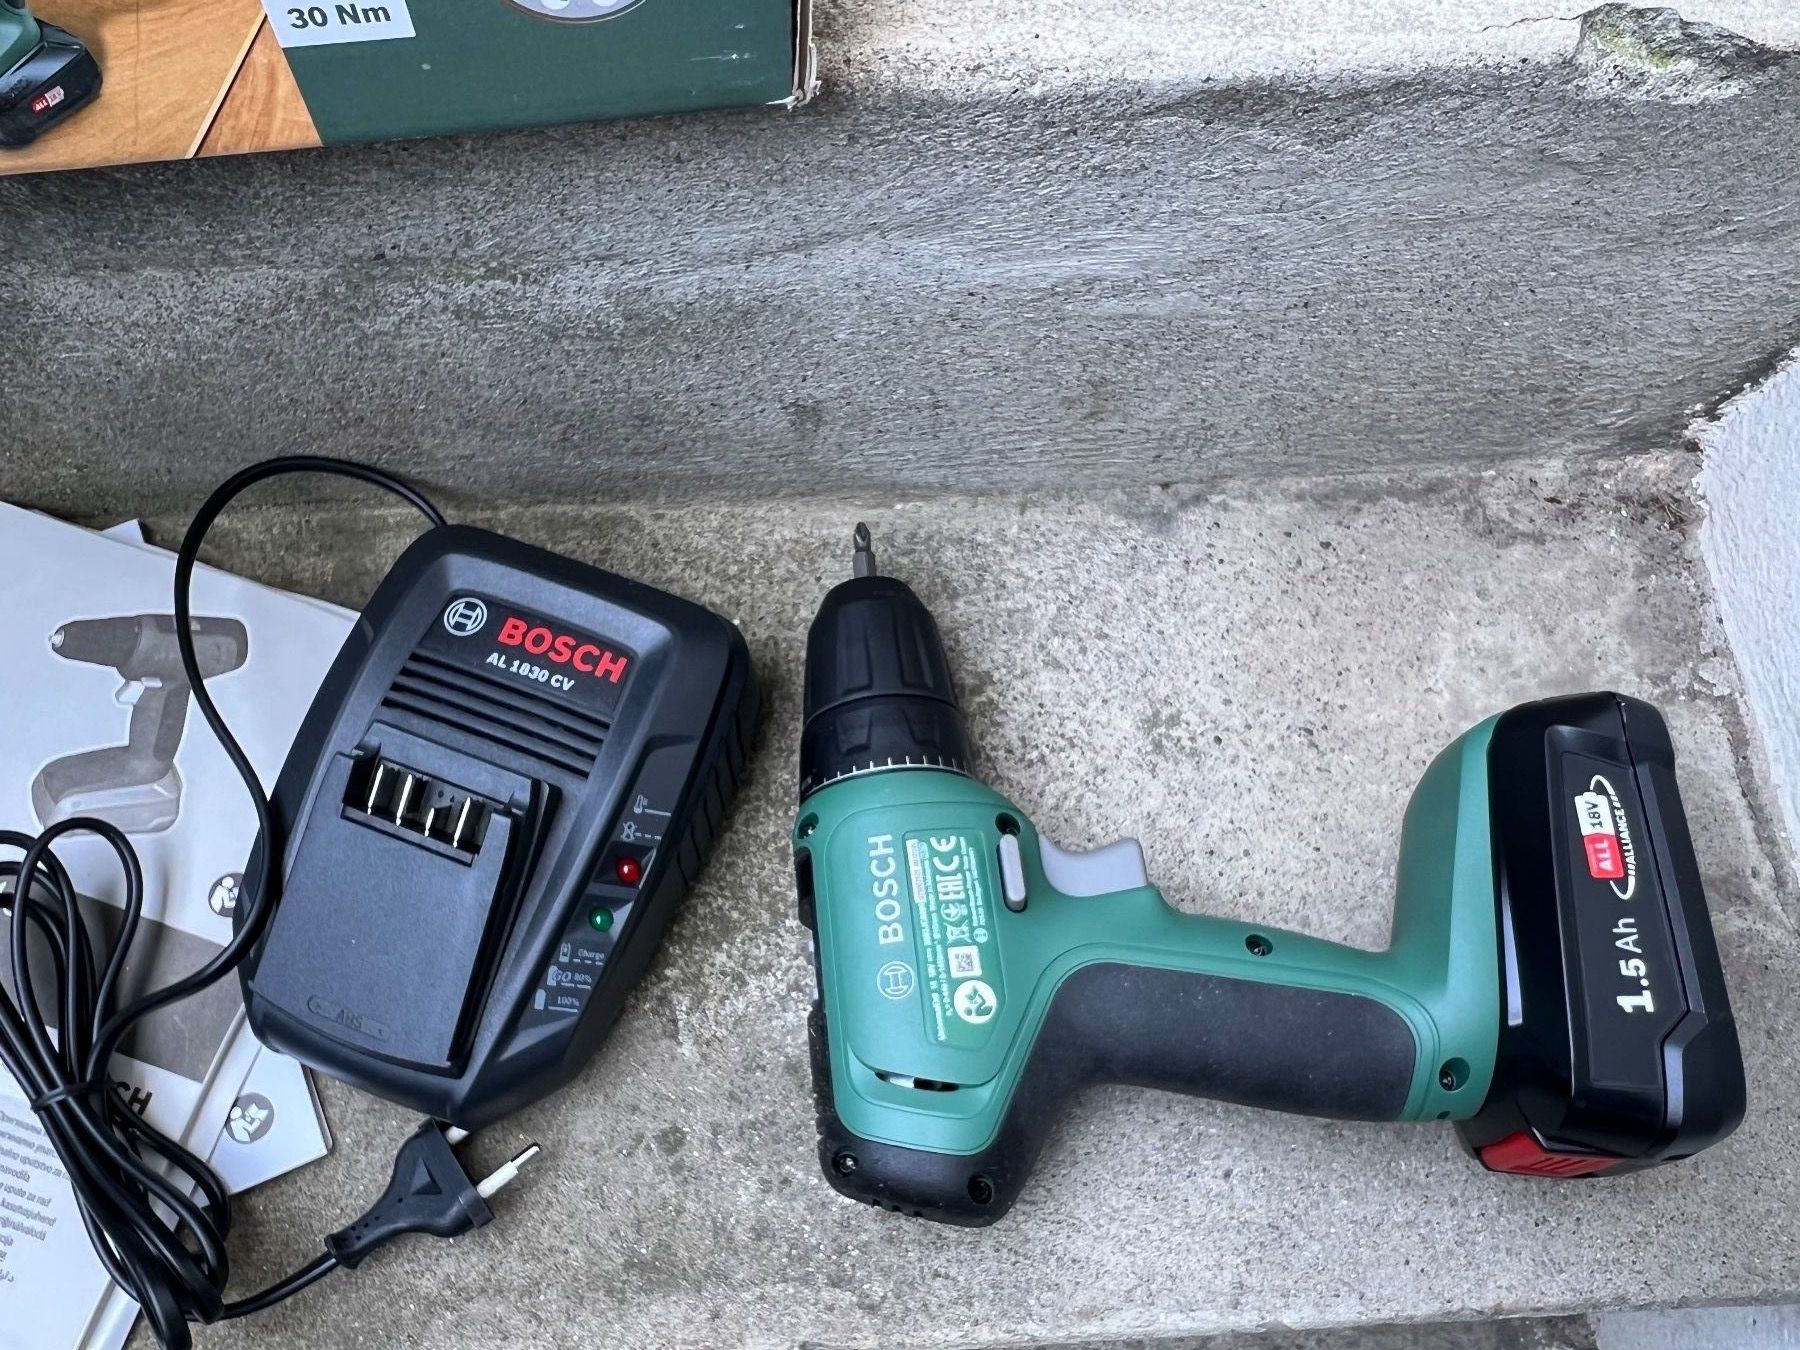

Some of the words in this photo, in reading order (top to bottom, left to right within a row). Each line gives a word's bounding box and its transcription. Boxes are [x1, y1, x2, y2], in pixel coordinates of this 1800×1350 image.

[287, 7, 328, 29] 30
[336, 2, 392, 26] Nm
[497, 616, 628, 684] BOSCH
[486, 652, 507, 669] AL
[550, 673, 575, 691] CV
[1584, 799, 1604, 830] 18V
[1593, 838, 1616, 872] ALL
[1614, 807, 1636, 865] ALLIANCE
[867, 833, 904, 945] BOSCH
